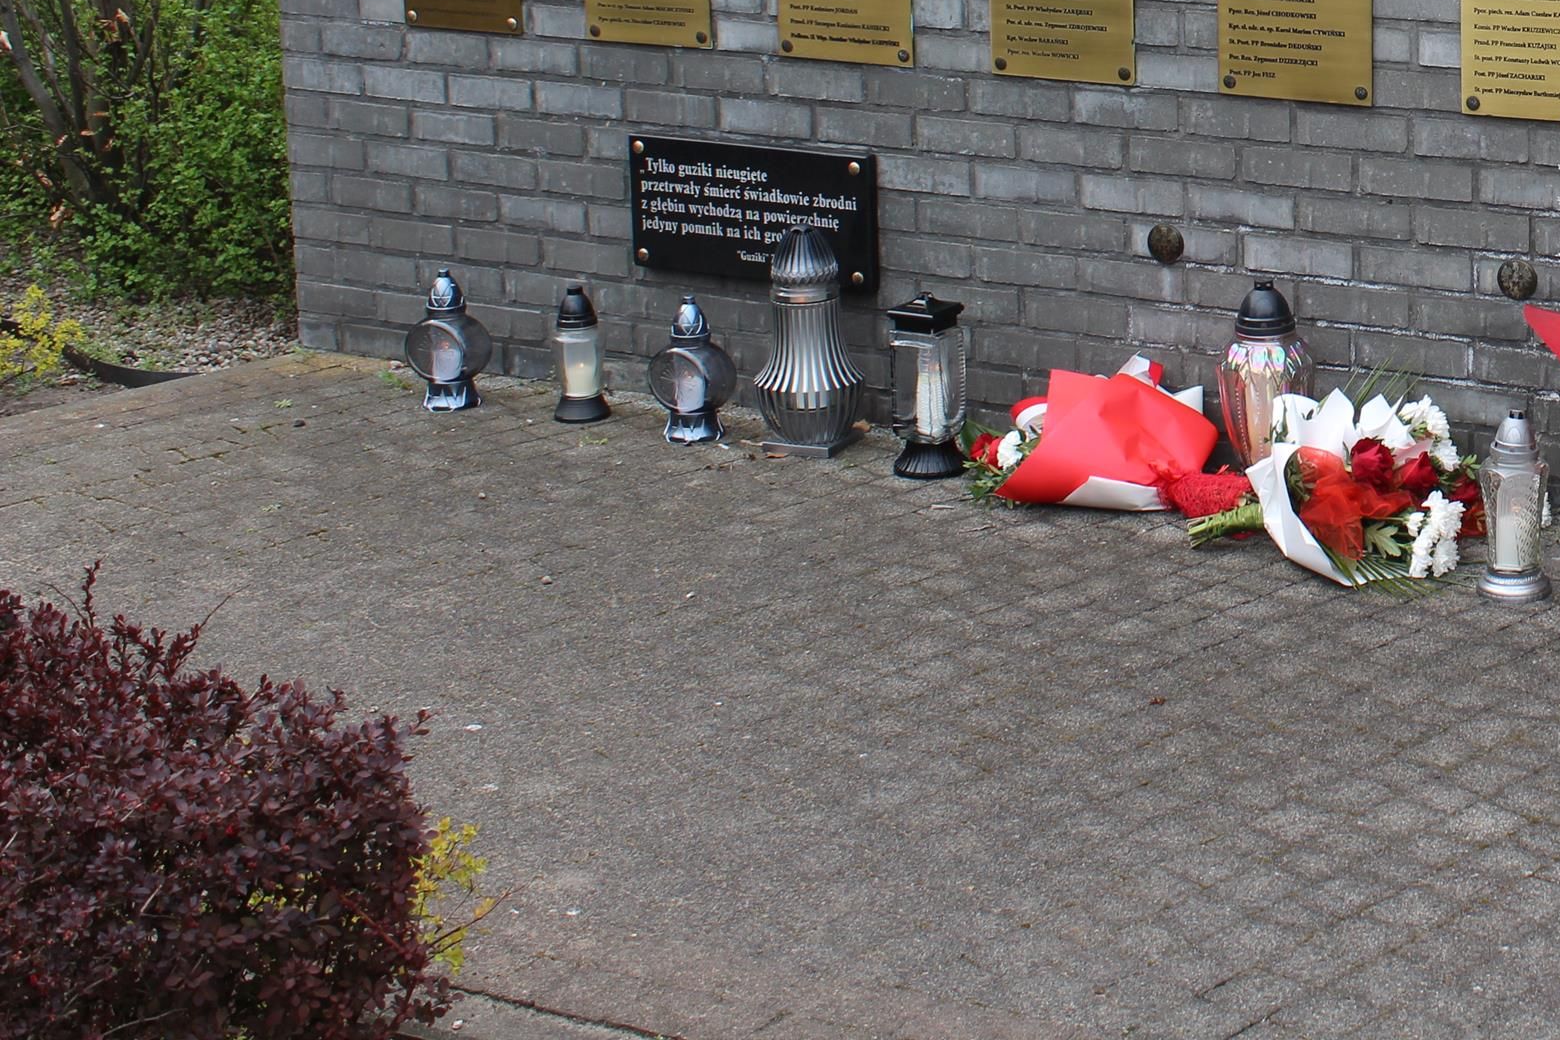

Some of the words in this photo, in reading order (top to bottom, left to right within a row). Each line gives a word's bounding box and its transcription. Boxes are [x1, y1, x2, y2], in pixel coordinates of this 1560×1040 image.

[678, 162, 712, 177] guziki
[716, 165, 767, 184] nieugięte
[641, 180, 701, 198] przetrwały
[704, 183, 741, 199] śmierć
[744, 187, 809, 206] świadkowie
[813, 193, 856, 211] zbrodni
[650, 197, 685, 214] głębin
[688, 202, 742, 222] wychodzą
[642, 215, 678, 234] jedyny
[681, 222, 723, 236] pomnik
[744, 225, 761, 240] ich
